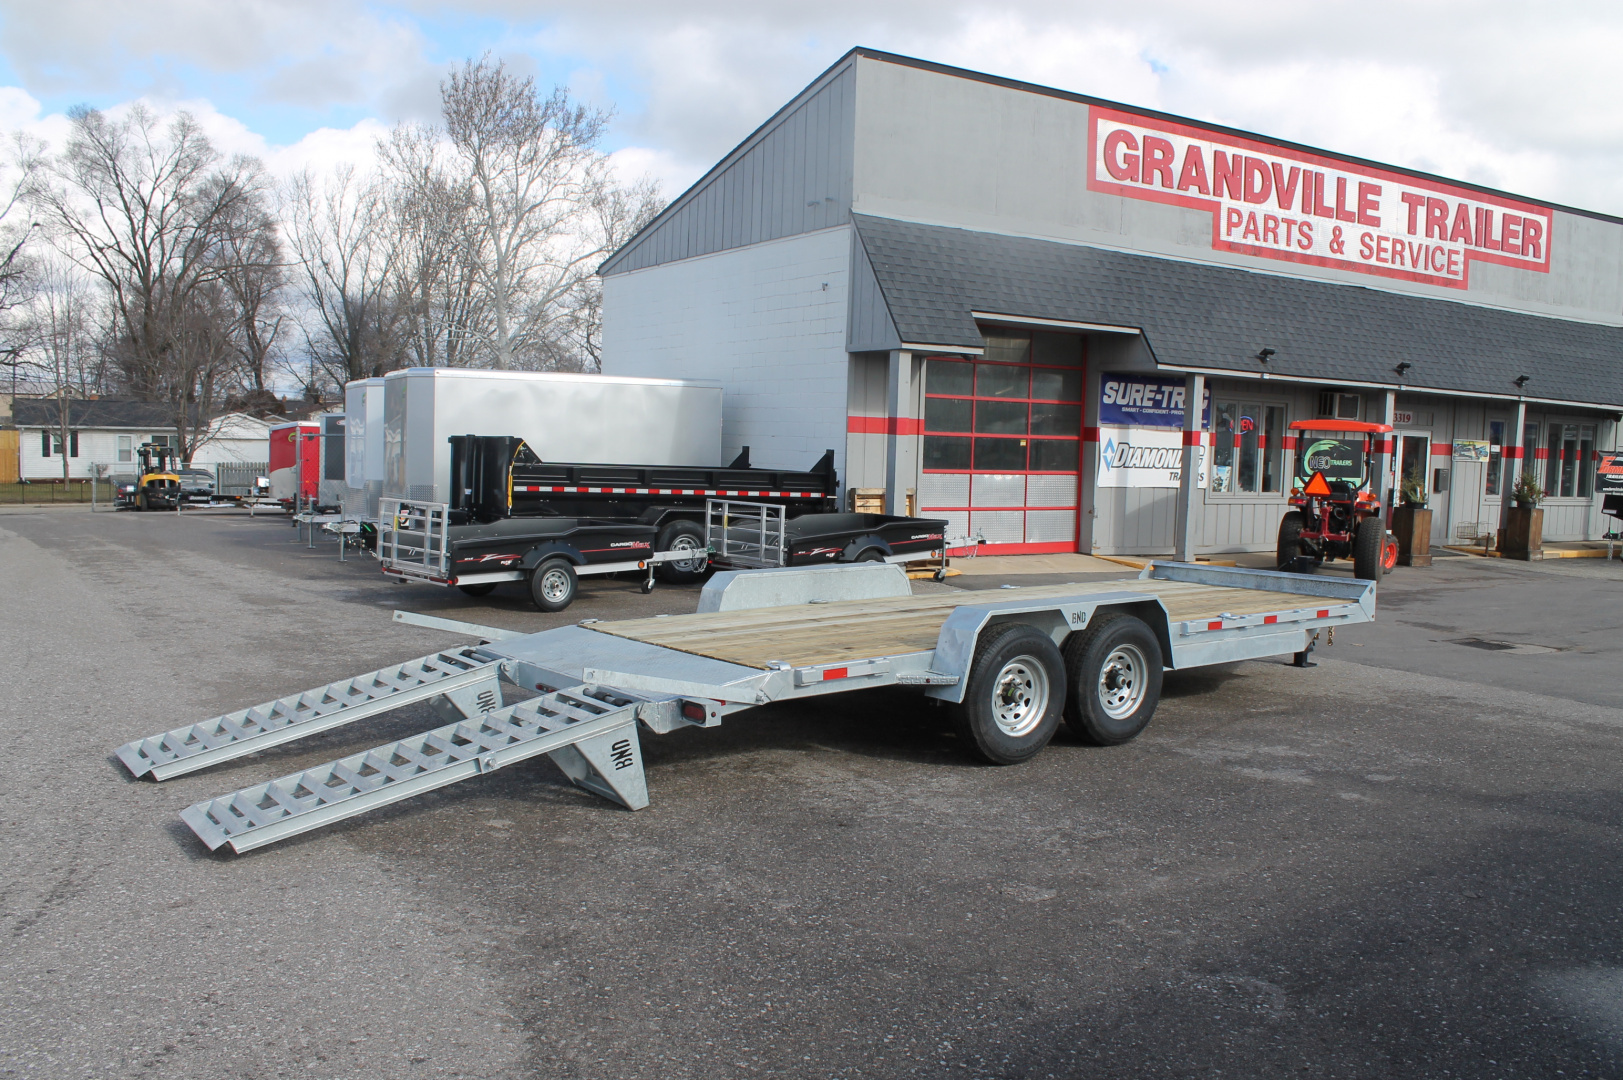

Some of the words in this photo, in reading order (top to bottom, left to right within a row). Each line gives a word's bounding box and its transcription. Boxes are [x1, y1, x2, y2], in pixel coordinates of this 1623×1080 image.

[1103, 128, 1382, 227] GRANDVILLE
[1401, 191, 1544, 260] TRAILER
[1226, 207, 1314, 250] PARTS
[1329, 226, 1345, 255] &
[1360, 231, 1461, 276] SERVICE
[1103, 381, 1210, 410] SURE-TRC
[1393, 413, 1411, 423] 3319
[1309, 455, 1331, 470] NEO
[1330, 459, 1353, 467] TRAILERS
[1071, 610, 1087, 624] BND
[610, 739, 634, 771] BND
